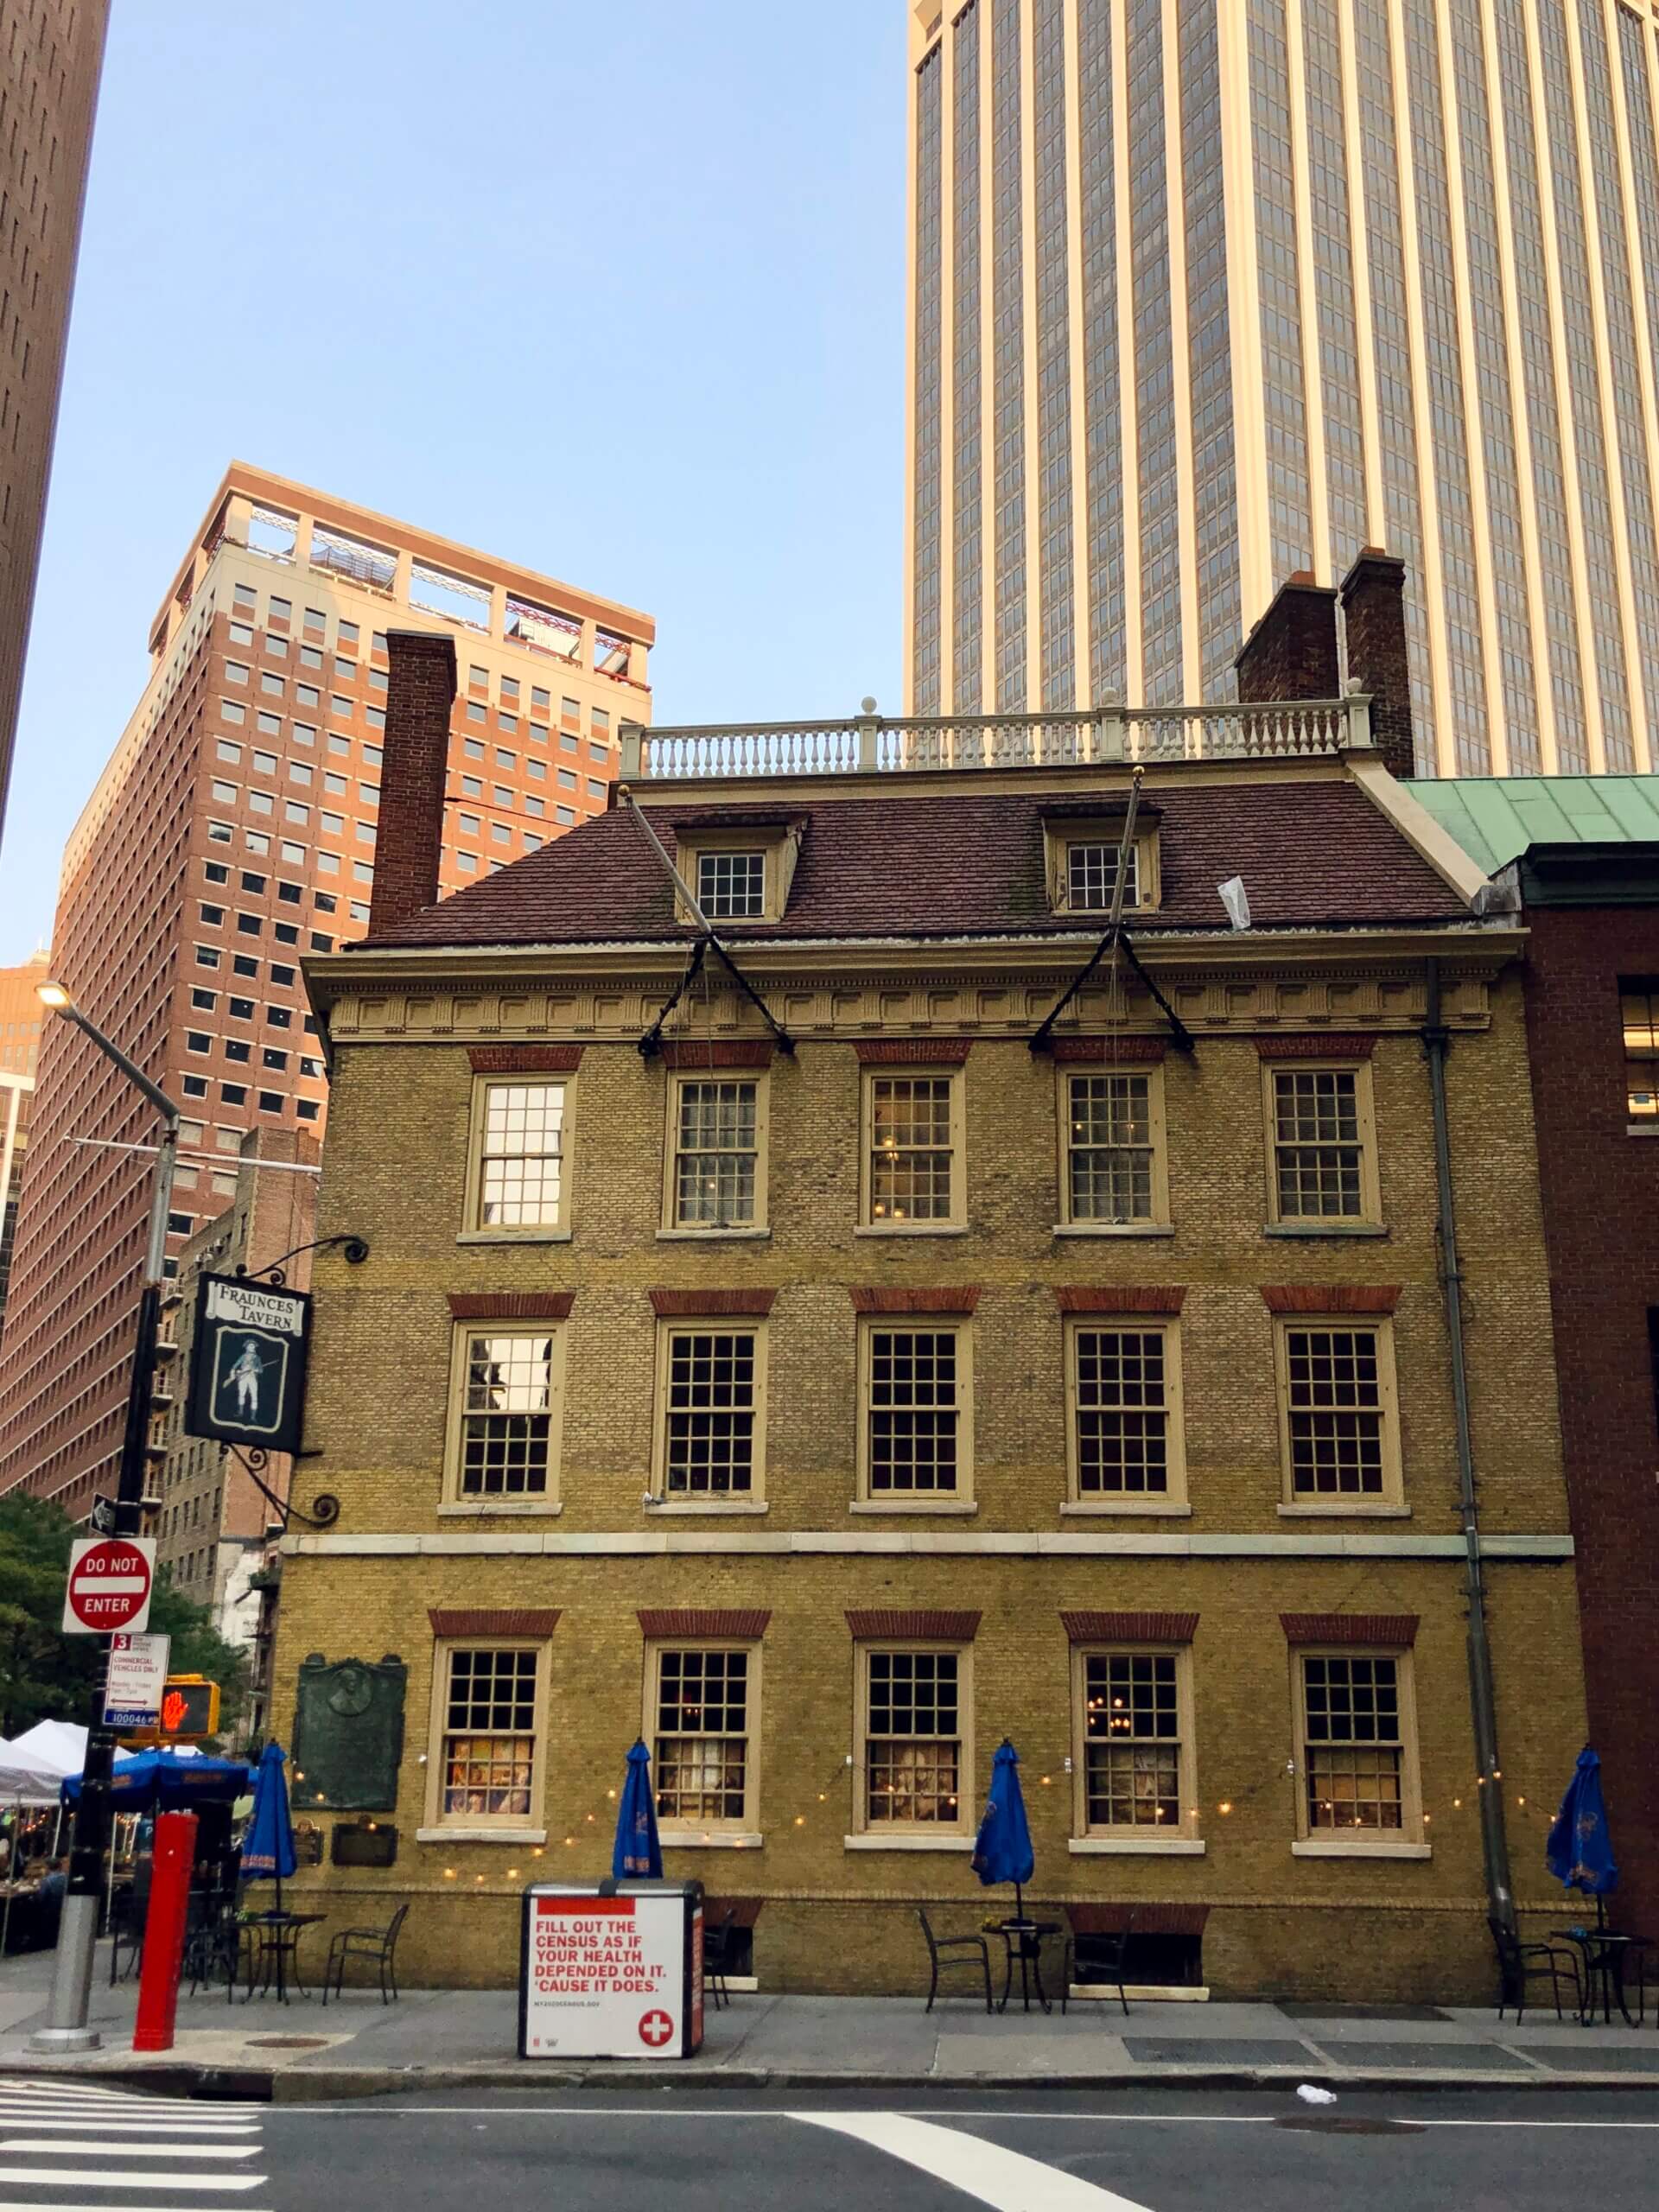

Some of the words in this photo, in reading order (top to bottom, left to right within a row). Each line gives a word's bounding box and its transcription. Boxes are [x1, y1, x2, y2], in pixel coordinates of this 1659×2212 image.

[219, 1285, 294, 1313] FRAUNCES
[239, 1306, 292, 1330] TAVERN
[86, 1558, 105, 1573] DO
[111, 1557, 138, 1572] NOT
[84, 1599, 130, 1613] ENTER
[118, 1635, 127, 1649] 3
[114, 1656, 153, 1665] COMMERCIAL
[113, 1664, 143, 1673] VEHICLES
[113, 1713, 147, 1724] 100046
[536, 1921, 568, 1933] FILL
[573, 1921, 603, 1933] OUT
[607, 1921, 636, 1933] THE
[536, 1936, 598, 1948] CENSUS
[603, 1936, 623, 1948] AS
[627, 1936, 642, 1948] IF
[537, 1950, 577, 1962] YOUR
[584, 1950, 642, 1962] HEALTH
[535, 1965, 618, 1977] DEPENDED
[623, 1965, 645, 1977] ON
[650, 1965, 667, 1977] IT.
[594, 1980, 607, 1992] IT
[612, 1980, 659, 1993] DOES.
